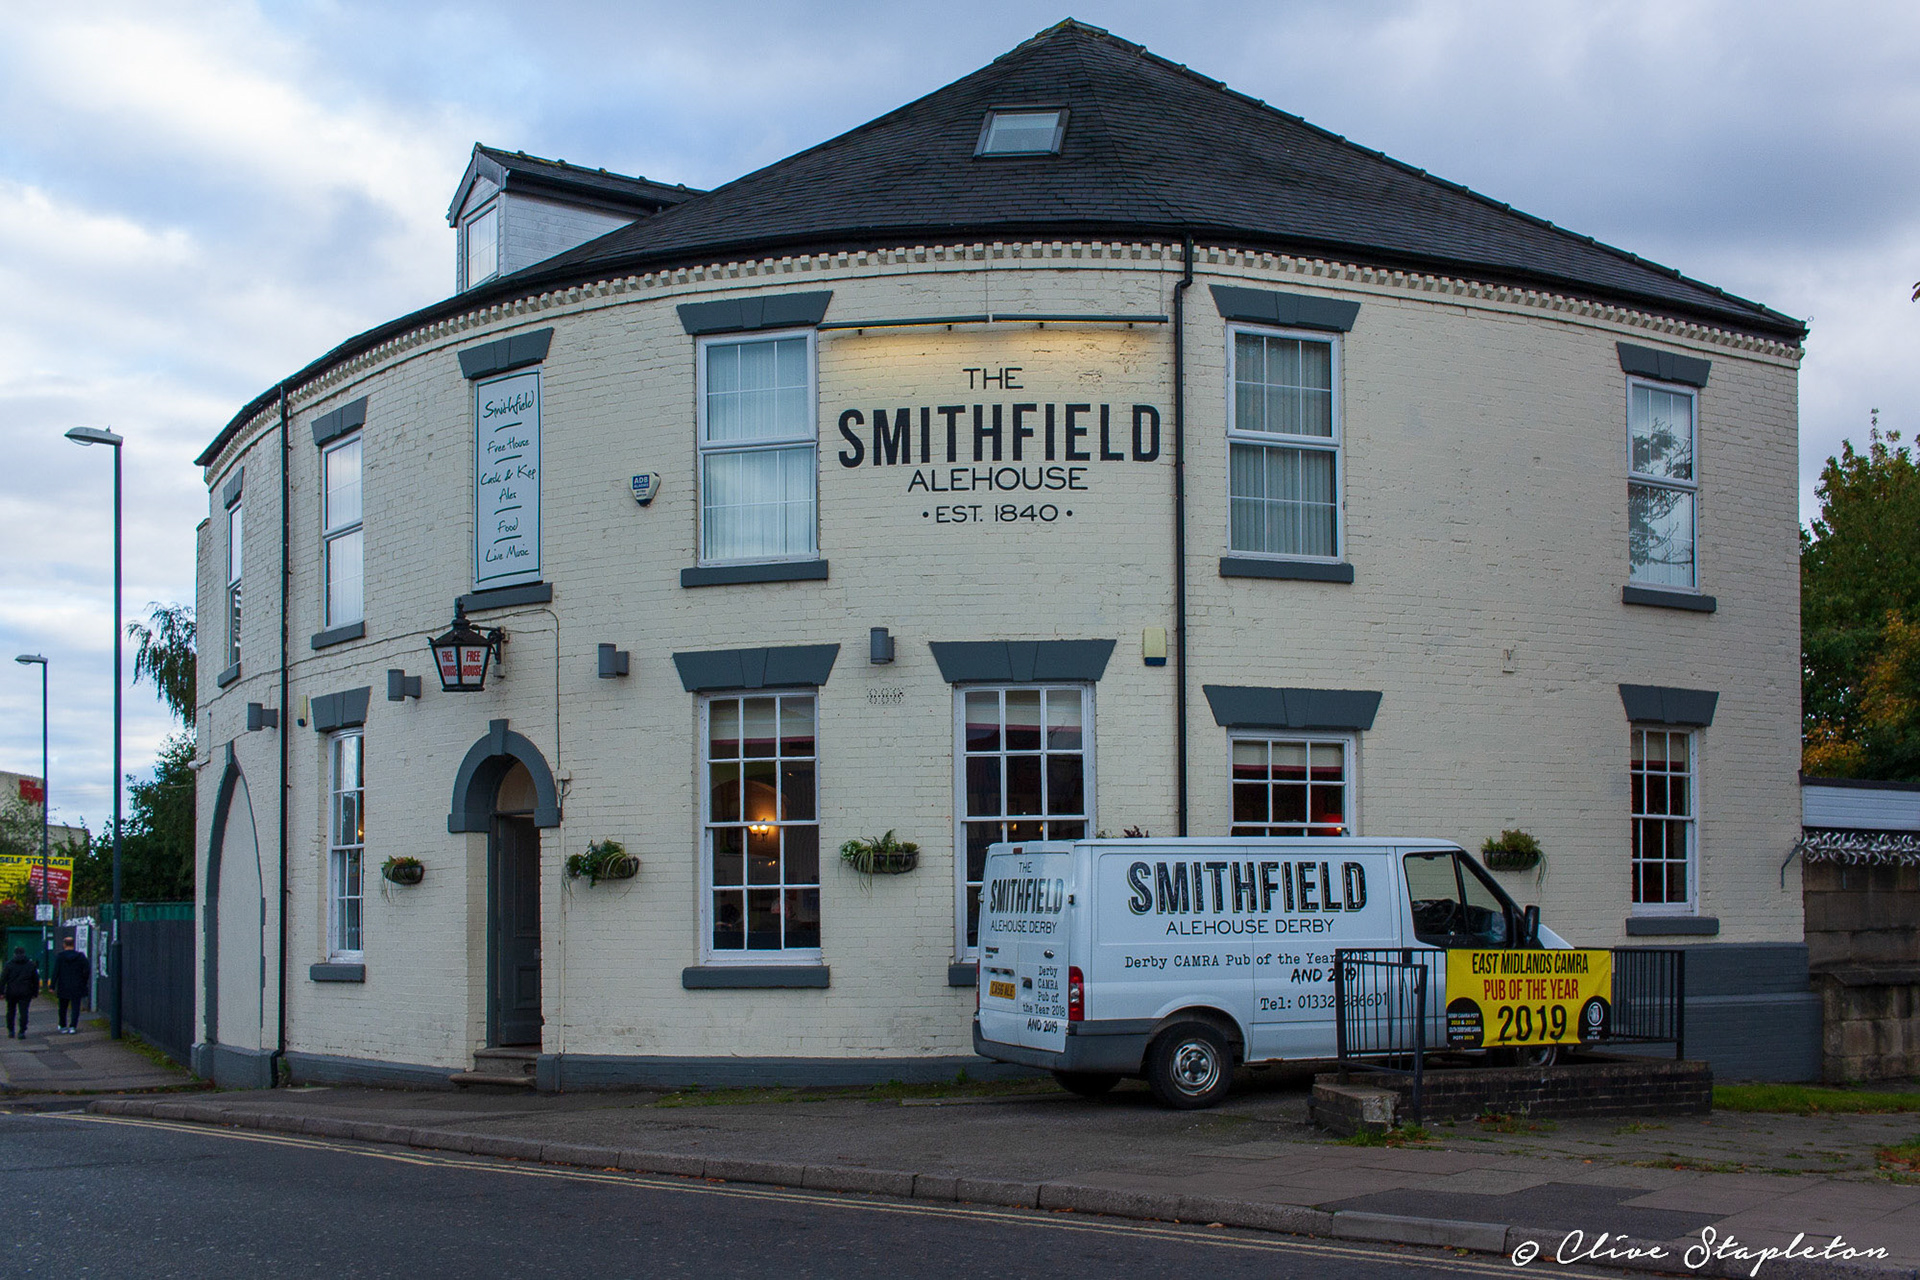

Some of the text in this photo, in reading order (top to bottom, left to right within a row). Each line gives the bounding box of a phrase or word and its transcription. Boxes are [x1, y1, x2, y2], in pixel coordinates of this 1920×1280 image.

[962, 367, 1024, 390] THE
[482, 390, 535, 419] Smithfield
[838, 403, 1161, 468] SMITHFIELD
[487, 437, 530, 454] Free House
[480, 465, 537, 487] Cask & Keg
[908, 466, 1088, 493] ALEHOUSE
[498, 488, 517, 504] Ales
[936, 504, 1059, 523] EST. 1840
[498, 518, 519, 534] Food
[486, 544, 530, 564] Live Music
[442, 650, 454, 662] FREE
[466, 650, 480, 662] FREE
[463, 665, 482, 676] HOUSE
[0, 856, 22, 864] SELF
[1018, 862, 1032, 873] THE
[990, 878, 1064, 914] SMITHFIELD
[1128, 861, 1368, 916] SMITHFIELD
[990, 920, 1058, 935] ALEHOUSE DERBY
[1166, 918, 1334, 936] ALEHOUSE DERBY
[1125, 956, 1168, 970] Derby
[1174, 955, 1220, 968] CAMRA
[1226, 954, 1251, 966] Pub
[1256, 953, 1272, 965] of
[1278, 952, 1300, 964] the
[1306, 952, 1336, 964] Year
[1472, 952, 1589, 975] EAST MIDLANDS CAMRA
[1038, 966, 1058, 978] Derby
[1291, 967, 1357, 985] AND 219
[1038, 978, 1058, 991] CAMRA
[1484, 978, 1580, 1002] PUB OF THE YEAR
[1038, 992, 1059, 1004] Pub of
[1260, 996, 1292, 1011] Tel:
[1298, 994, 1336, 1010] 01332
[1022, 1003, 1066, 1017] the Year 2018
[1027, 1018, 1058, 1034] AND 2019
[1497, 1004, 1568, 1043] 2019
